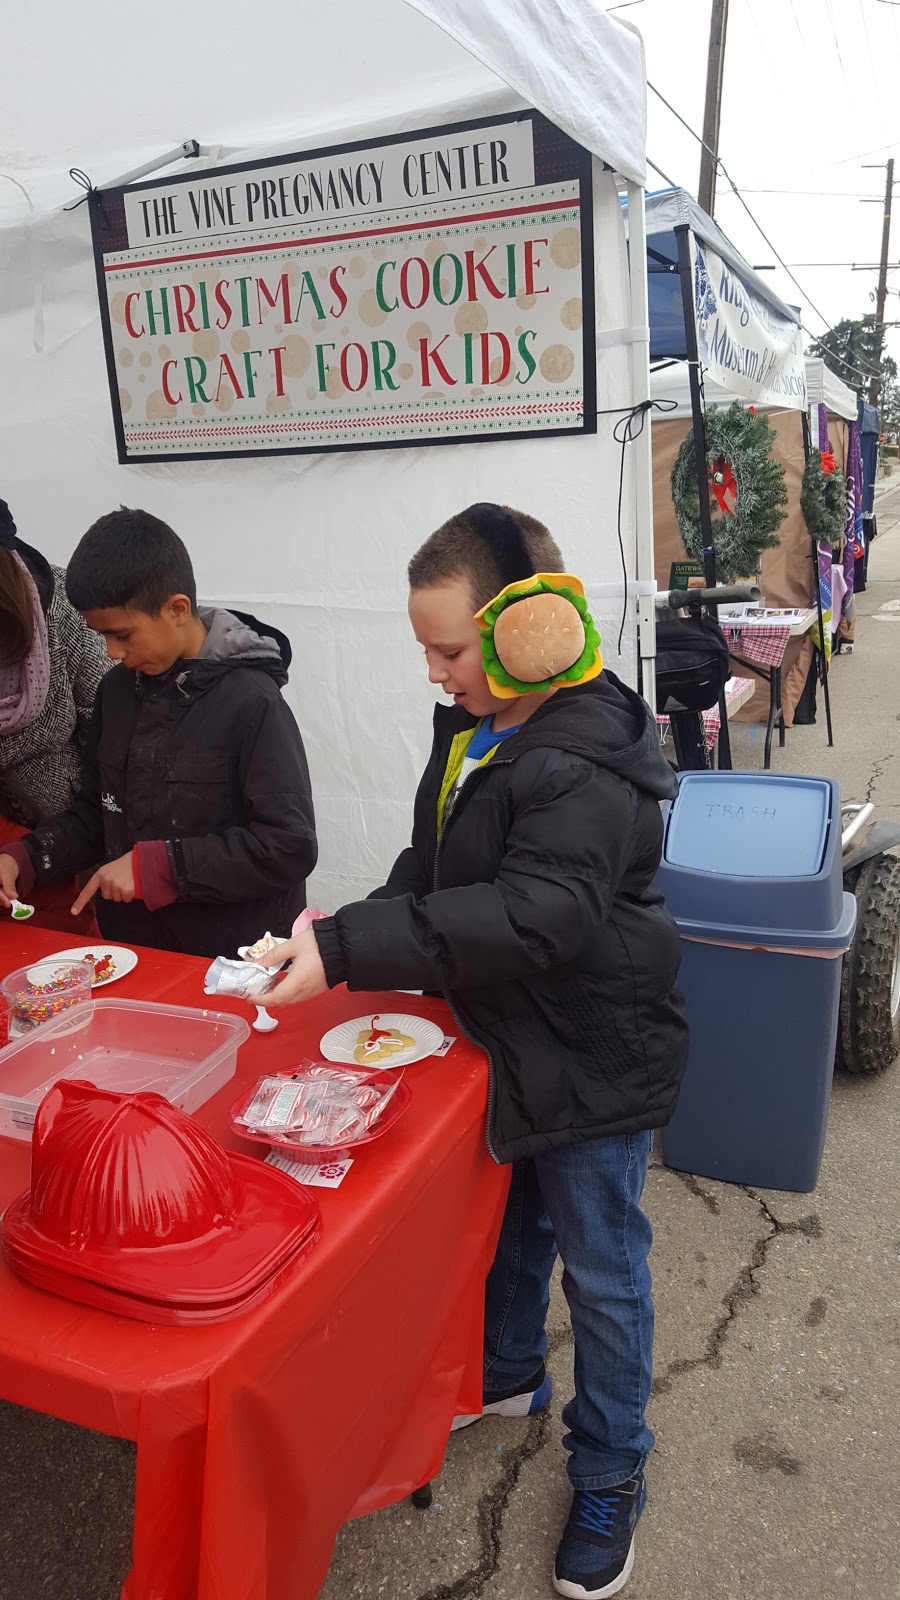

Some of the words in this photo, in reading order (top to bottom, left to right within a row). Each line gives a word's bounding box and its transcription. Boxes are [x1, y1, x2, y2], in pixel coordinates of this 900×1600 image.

[138, 195, 182, 238] THE
[188, 186, 241, 230] VINE
[245, 160, 384, 223] PREGNANCY
[402, 140, 510, 198] CENTER
[124, 265, 348, 339] CHRISTMAS
[375, 238, 550, 313] COOKIE
[161, 346, 287, 406] CRAFT
[315, 339, 400, 393] FOR
[419, 329, 538, 388] KIDS
[711, 318, 759, 381] Museum
[705, 803, 777, 819] TRASH
